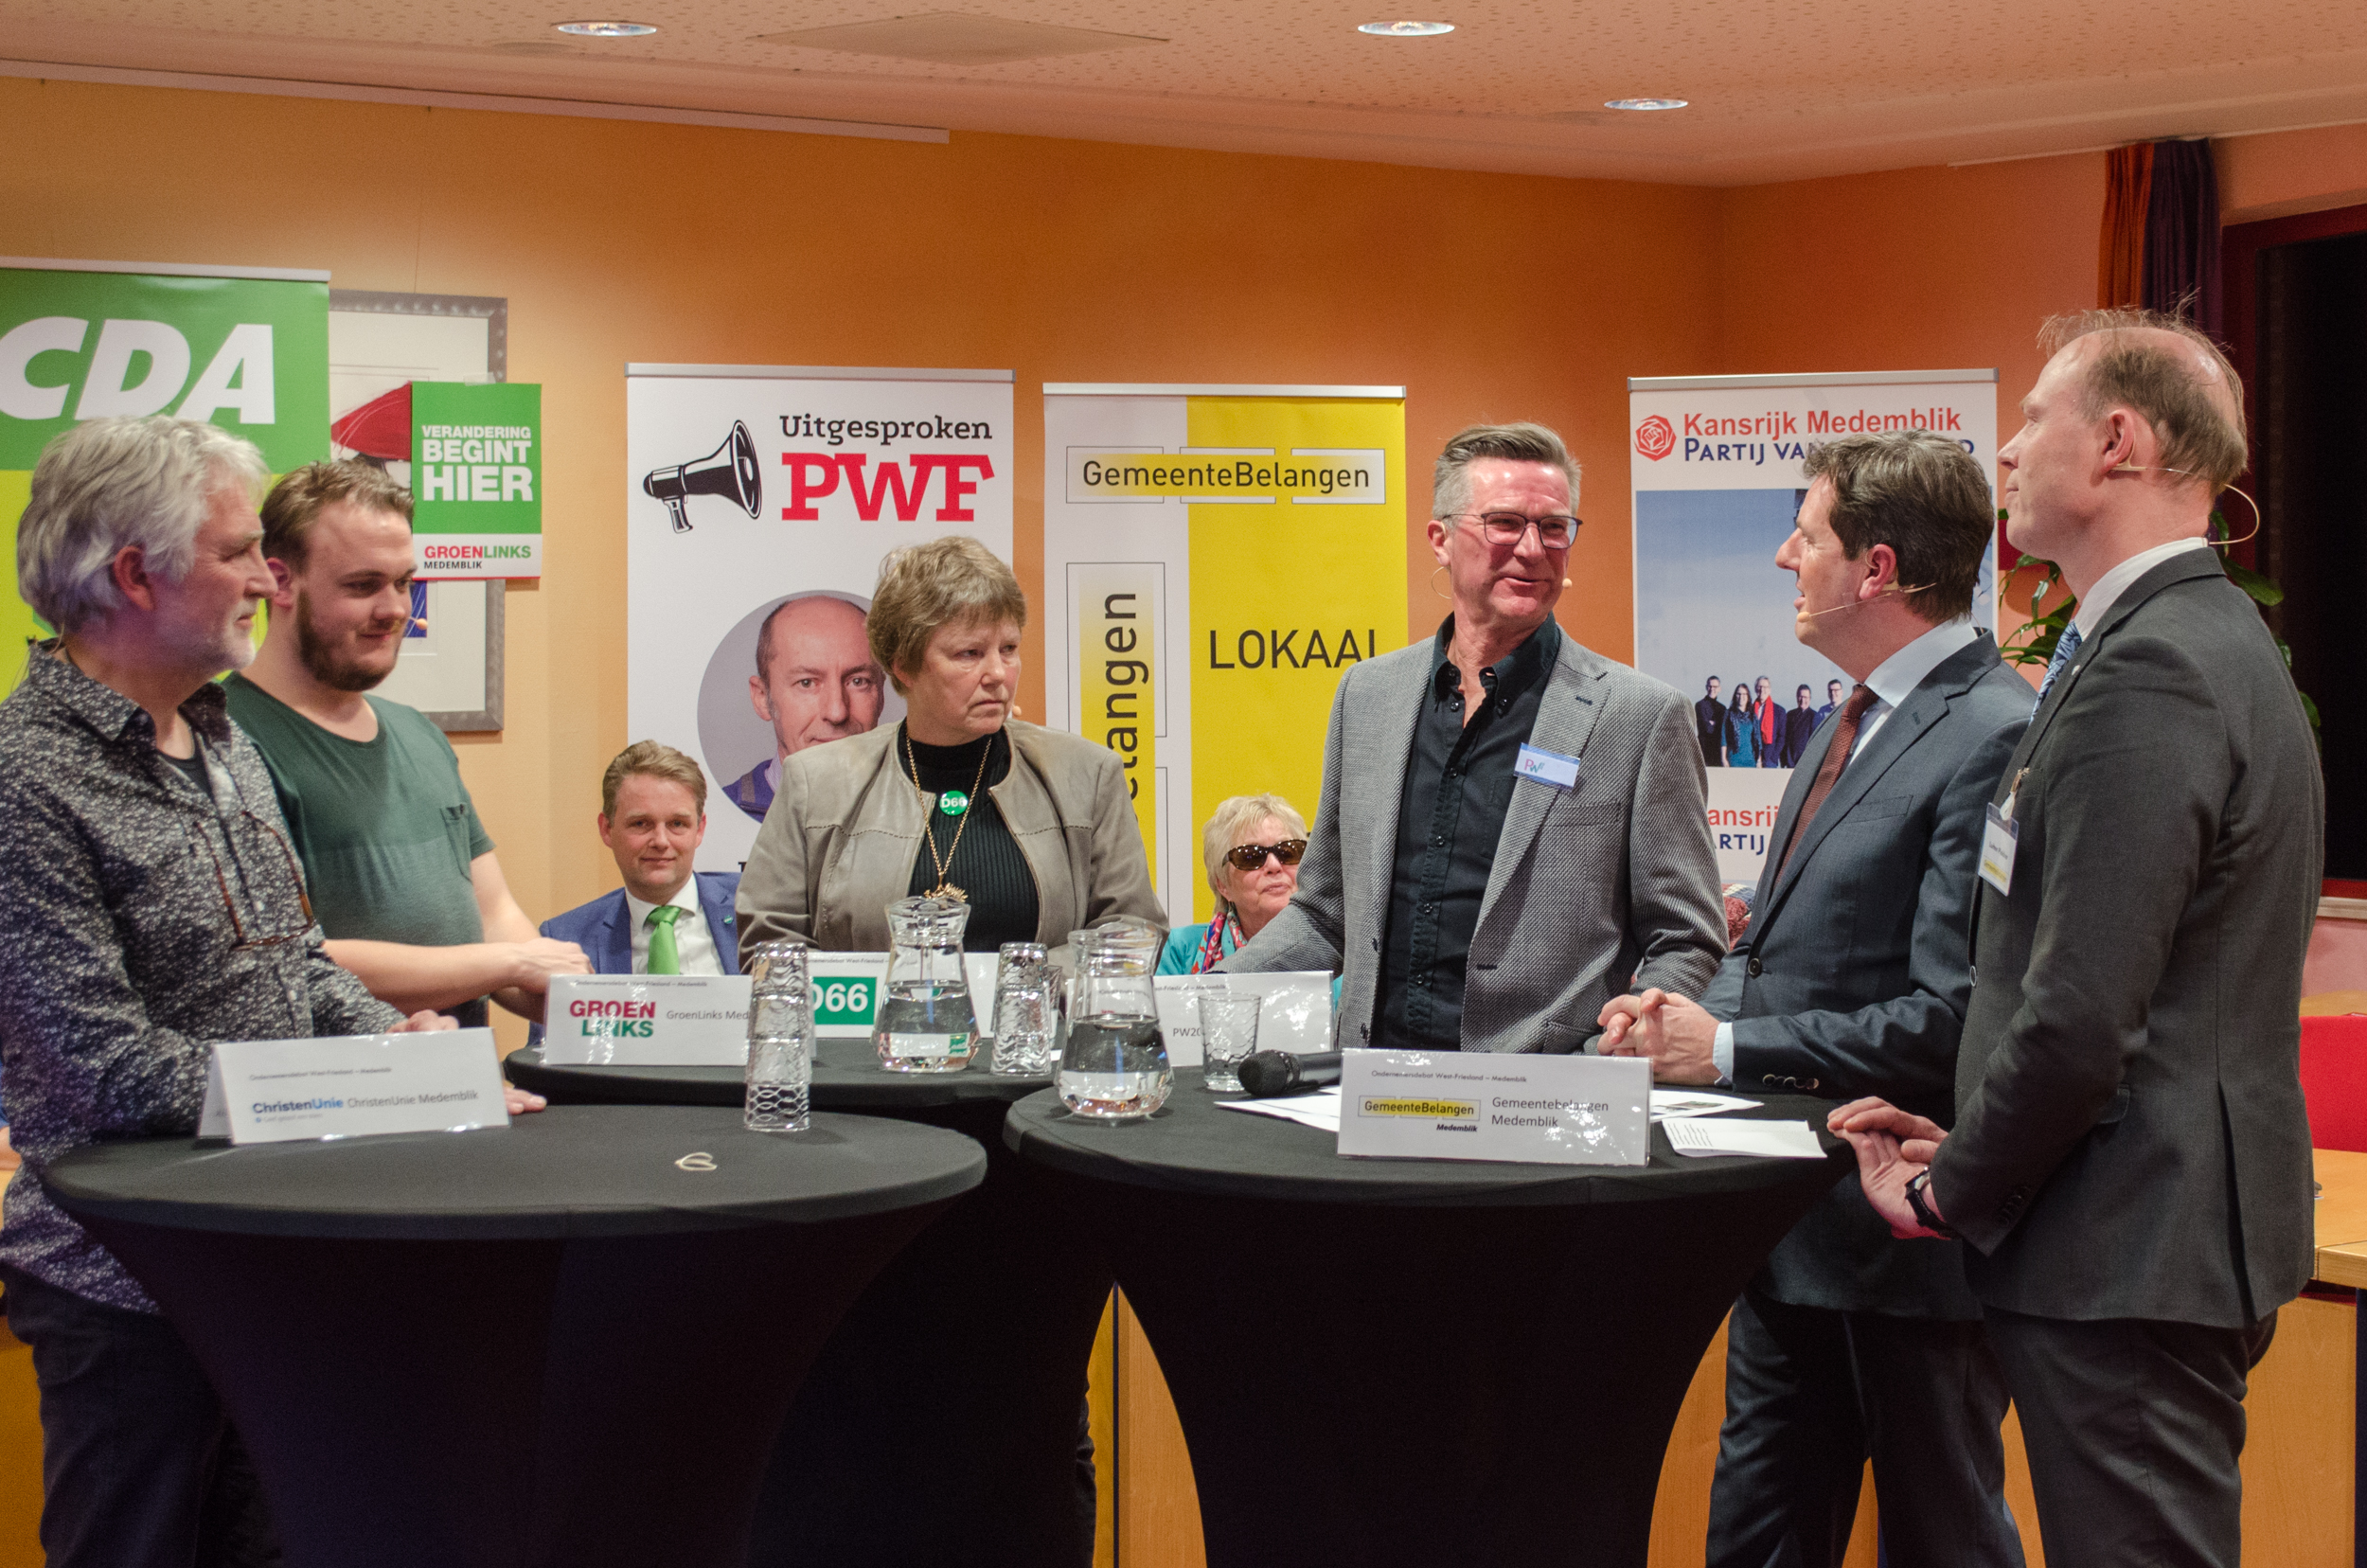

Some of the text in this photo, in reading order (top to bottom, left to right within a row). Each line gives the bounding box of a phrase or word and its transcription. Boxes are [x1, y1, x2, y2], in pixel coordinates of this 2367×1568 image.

[0, 316, 276, 424] CDA
[421, 425, 531, 439] VERANDERING
[779, 413, 992, 446] Uitgesproken
[1683, 407, 1962, 440] Kansrijk Medemblik
[422, 439, 532, 464] BEGINT
[1684, 437, 1764, 466] PARTIJ
[422, 465, 534, 502] HIER
[781, 453, 995, 522] PWF
[1082, 460, 1370, 494] GemeenteBelangen
[424, 545, 531, 559] GROENLINKS
[423, 561, 483, 569] MEDEMBLIK
[1718, 833, 1764, 856] RTIJ
[569, 1000, 656, 1019] GROEN
[667, 1009, 722, 1020] GroenLinks
[581, 1019, 654, 1038] LINKS
[252, 1090, 479, 1114] ChristenUnie ChristenUnie Medemblik
[1364, 1100, 1474, 1116] GemeenteBelangen
[1436, 1124, 1478, 1132] Medemblik
[1491, 1114, 1558, 1128] Medemblik
